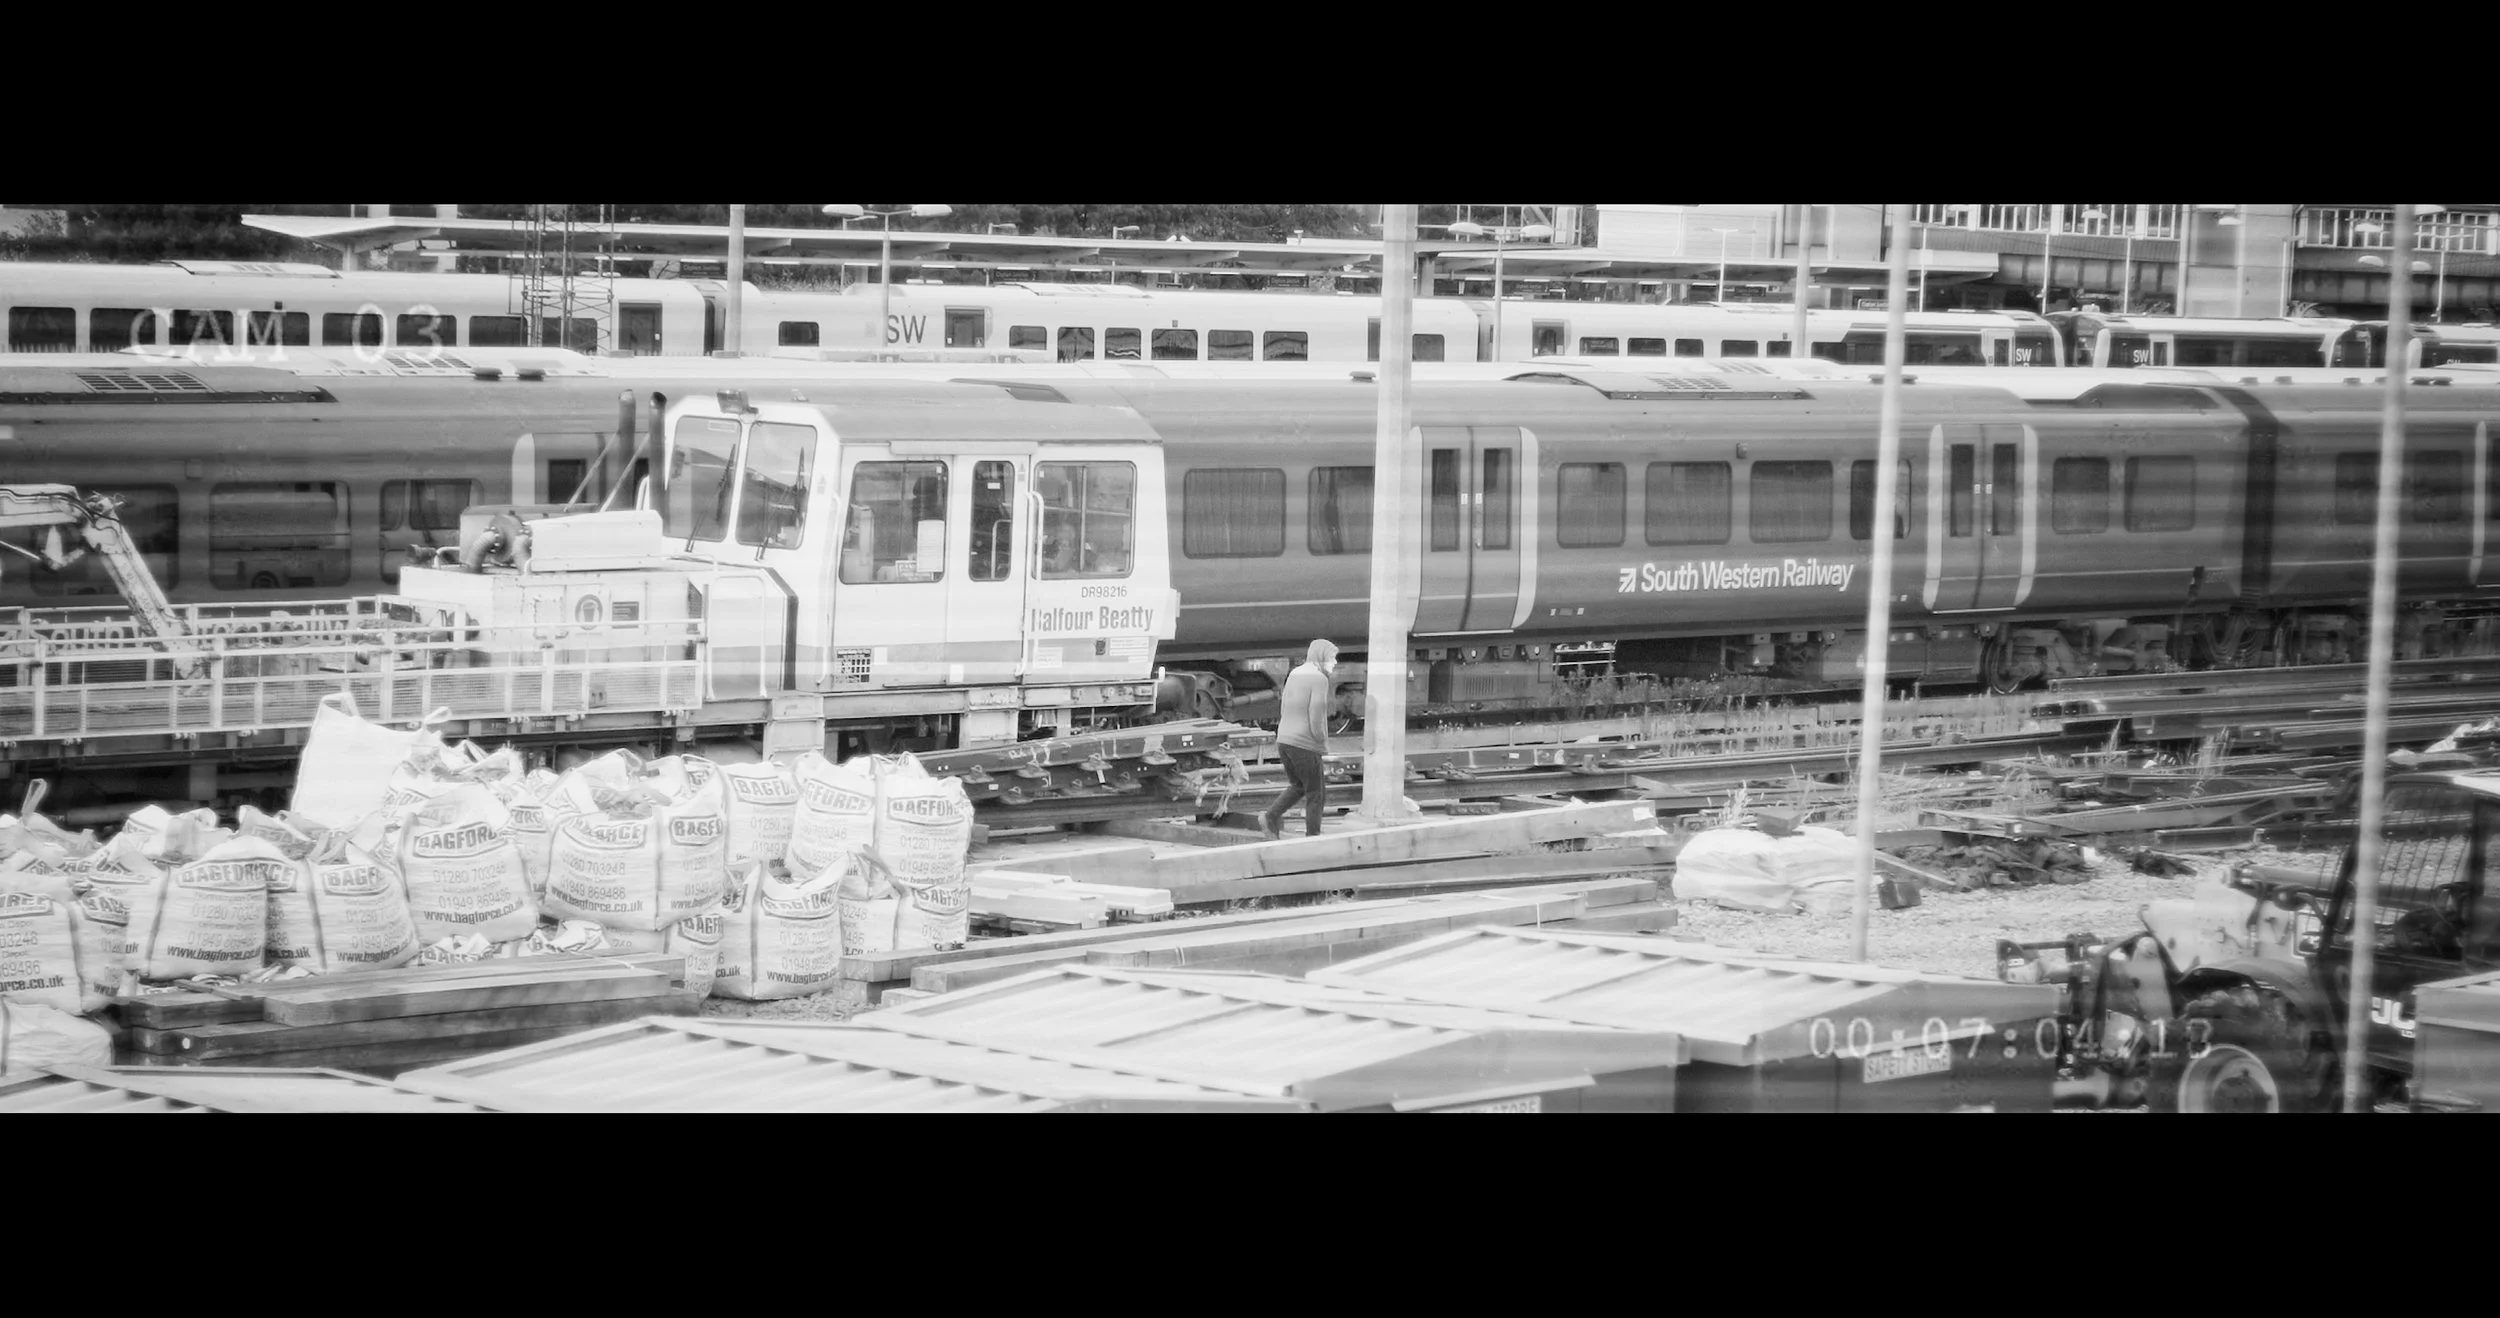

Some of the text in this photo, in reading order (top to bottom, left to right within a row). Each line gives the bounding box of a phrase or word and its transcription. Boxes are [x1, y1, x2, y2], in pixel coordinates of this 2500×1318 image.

[887, 314, 927, 344] SW
[2015, 347, 2032, 363] SW
[2132, 349, 2149, 363] SW
[1640, 557, 1855, 593] South Western Railway
[1080, 586, 1128, 598] DR98216
[1098, 605, 1154, 632] Beatty
